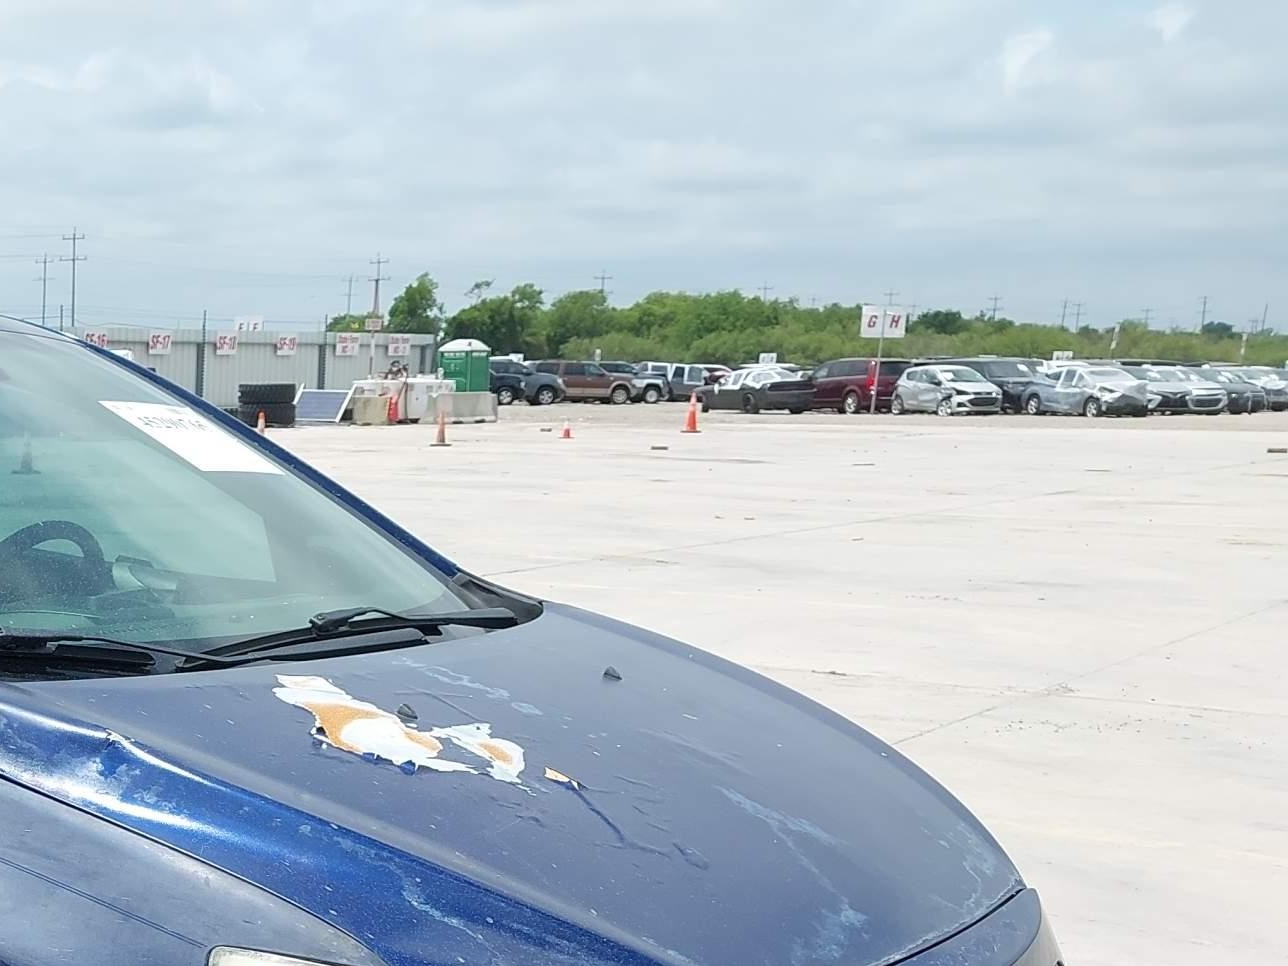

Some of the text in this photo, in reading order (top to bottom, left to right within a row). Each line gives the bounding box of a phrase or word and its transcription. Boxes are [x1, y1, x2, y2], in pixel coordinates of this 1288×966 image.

[867, 314, 878, 329] G
[889, 314, 901, 329] H
[151, 334, 171, 350] SF-17
